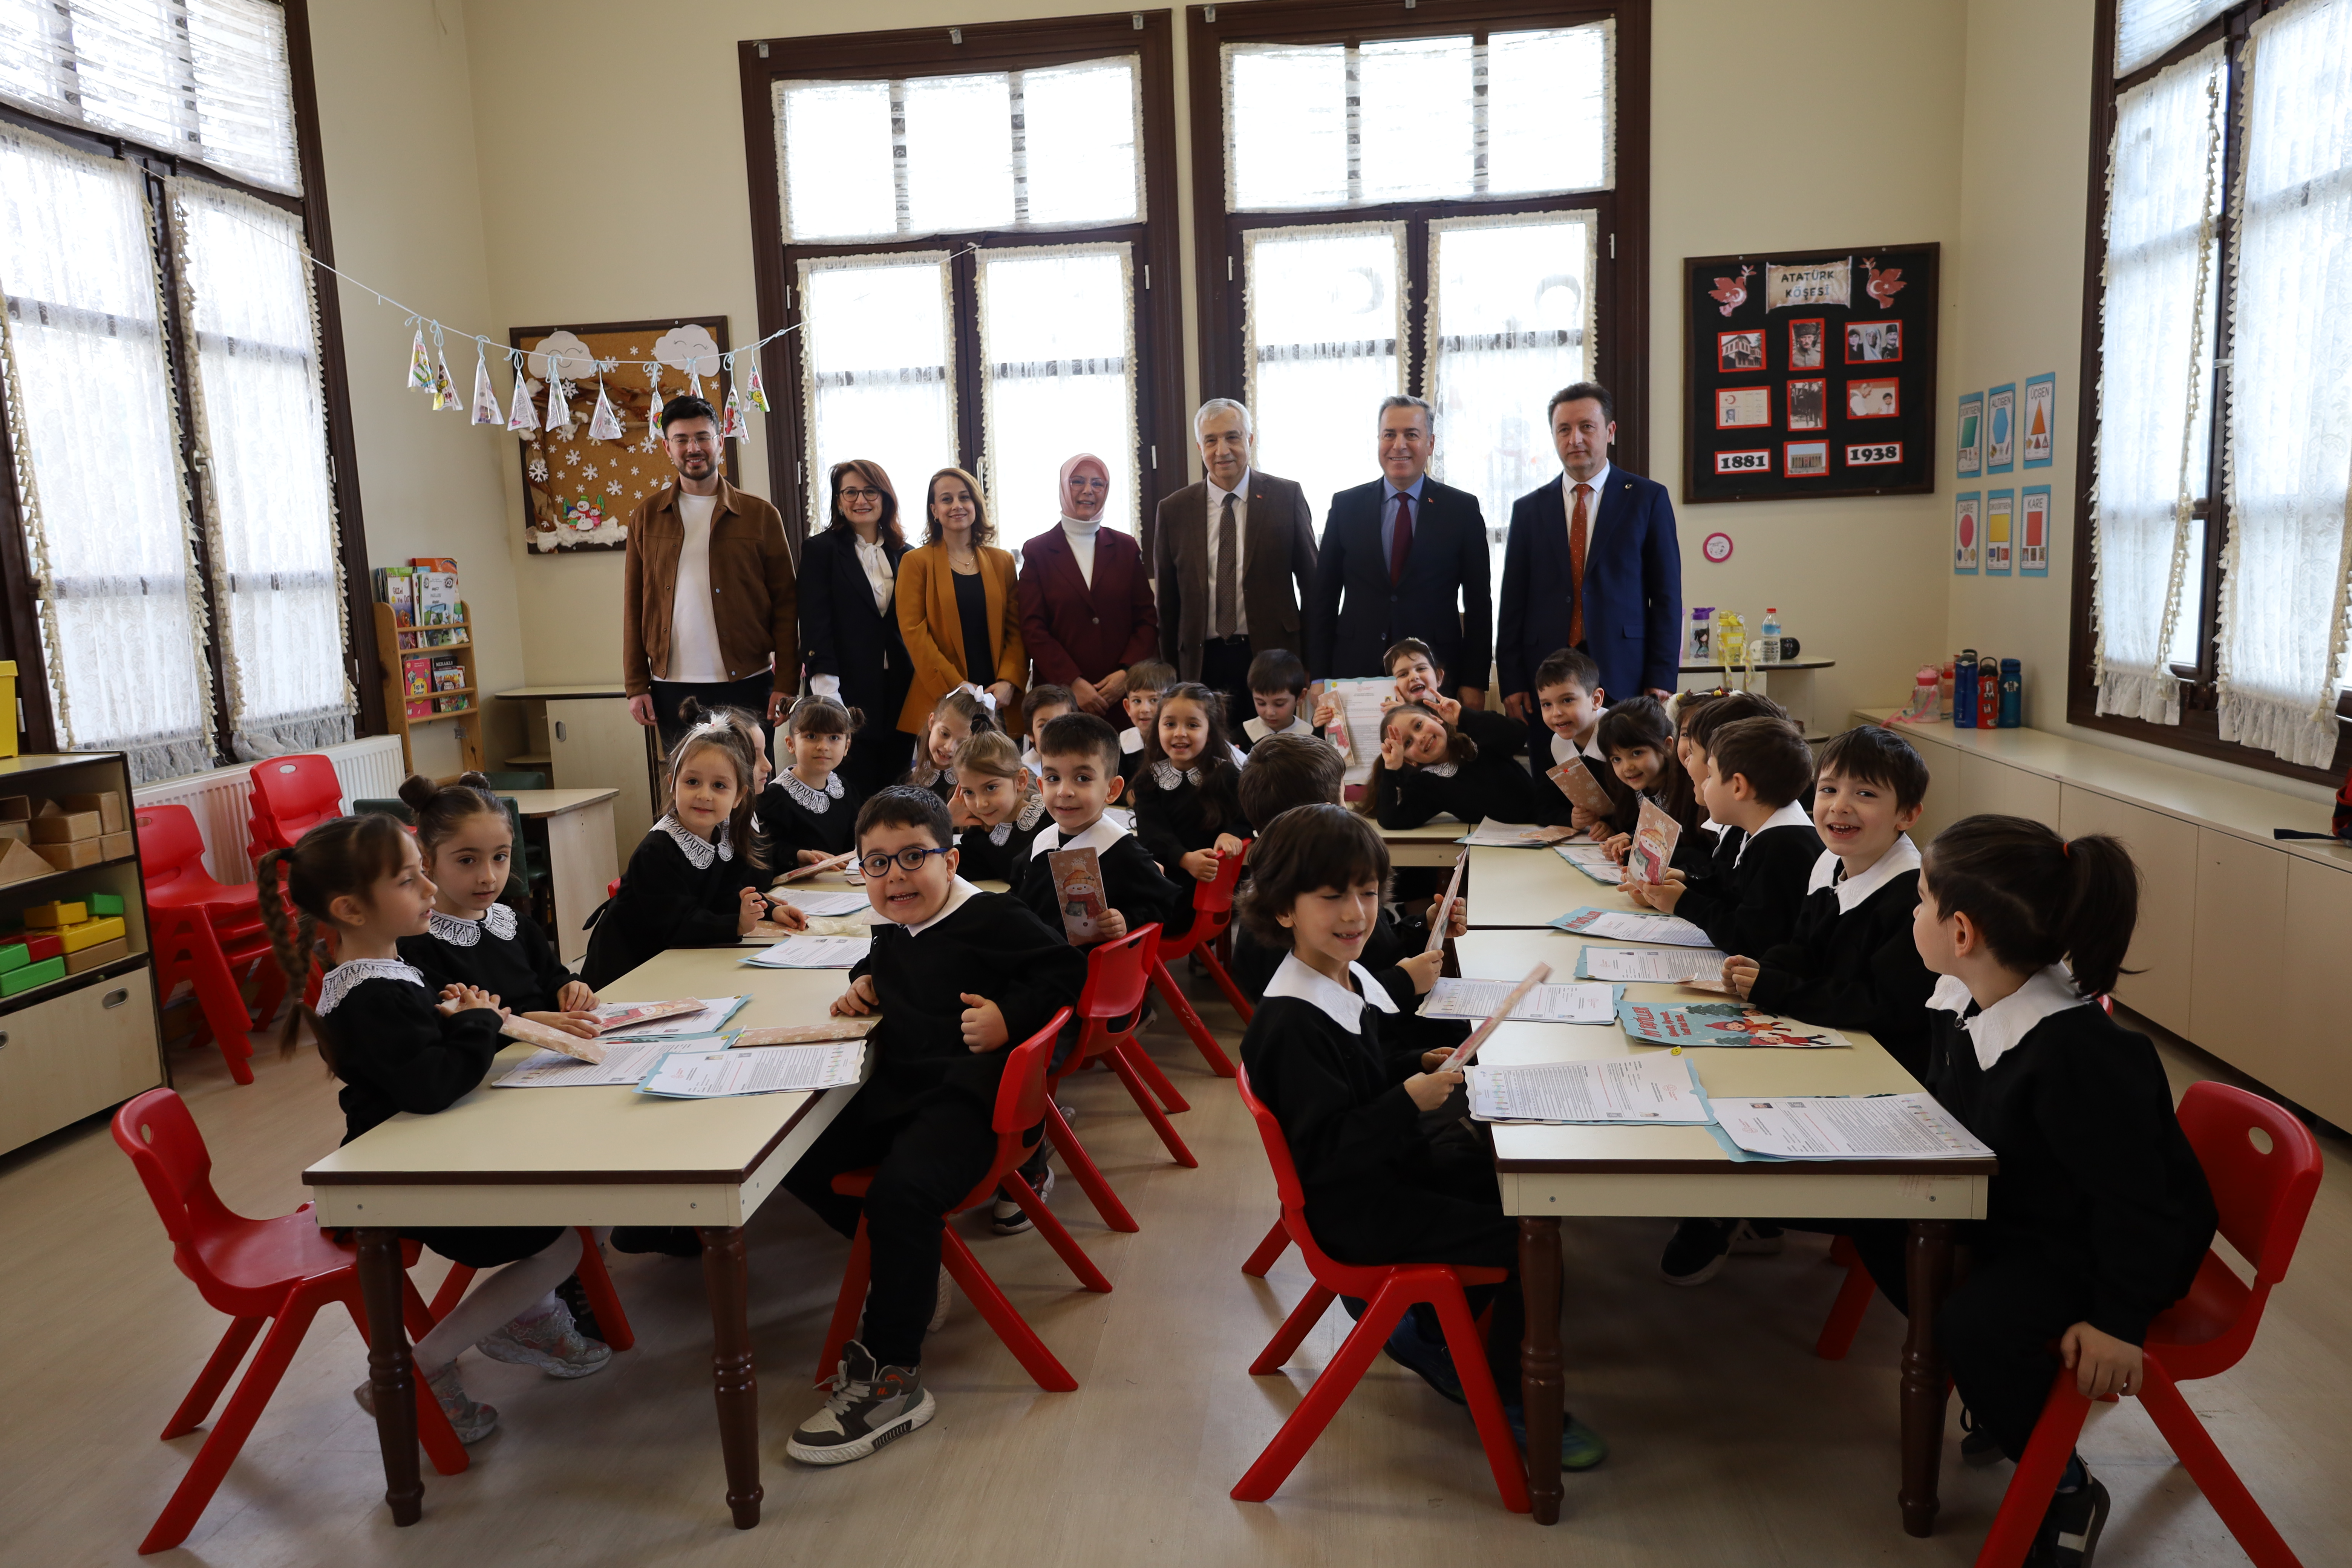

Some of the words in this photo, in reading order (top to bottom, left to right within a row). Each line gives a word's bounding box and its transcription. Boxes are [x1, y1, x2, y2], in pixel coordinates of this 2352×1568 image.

[1781, 269, 1834, 282] ATATÜRK
[1785, 284, 1830, 300] KÖŞESİ
[2030, 387, 2049, 401] ÜÇGEN
[1991, 396, 2011, 408] ALTIGEN
[1850, 446, 1897, 462] 1938
[1721, 455, 1766, 469] 1881
[2027, 498, 2044, 509] KARE
[1632, 1007, 1658, 1029] TATİLLER
